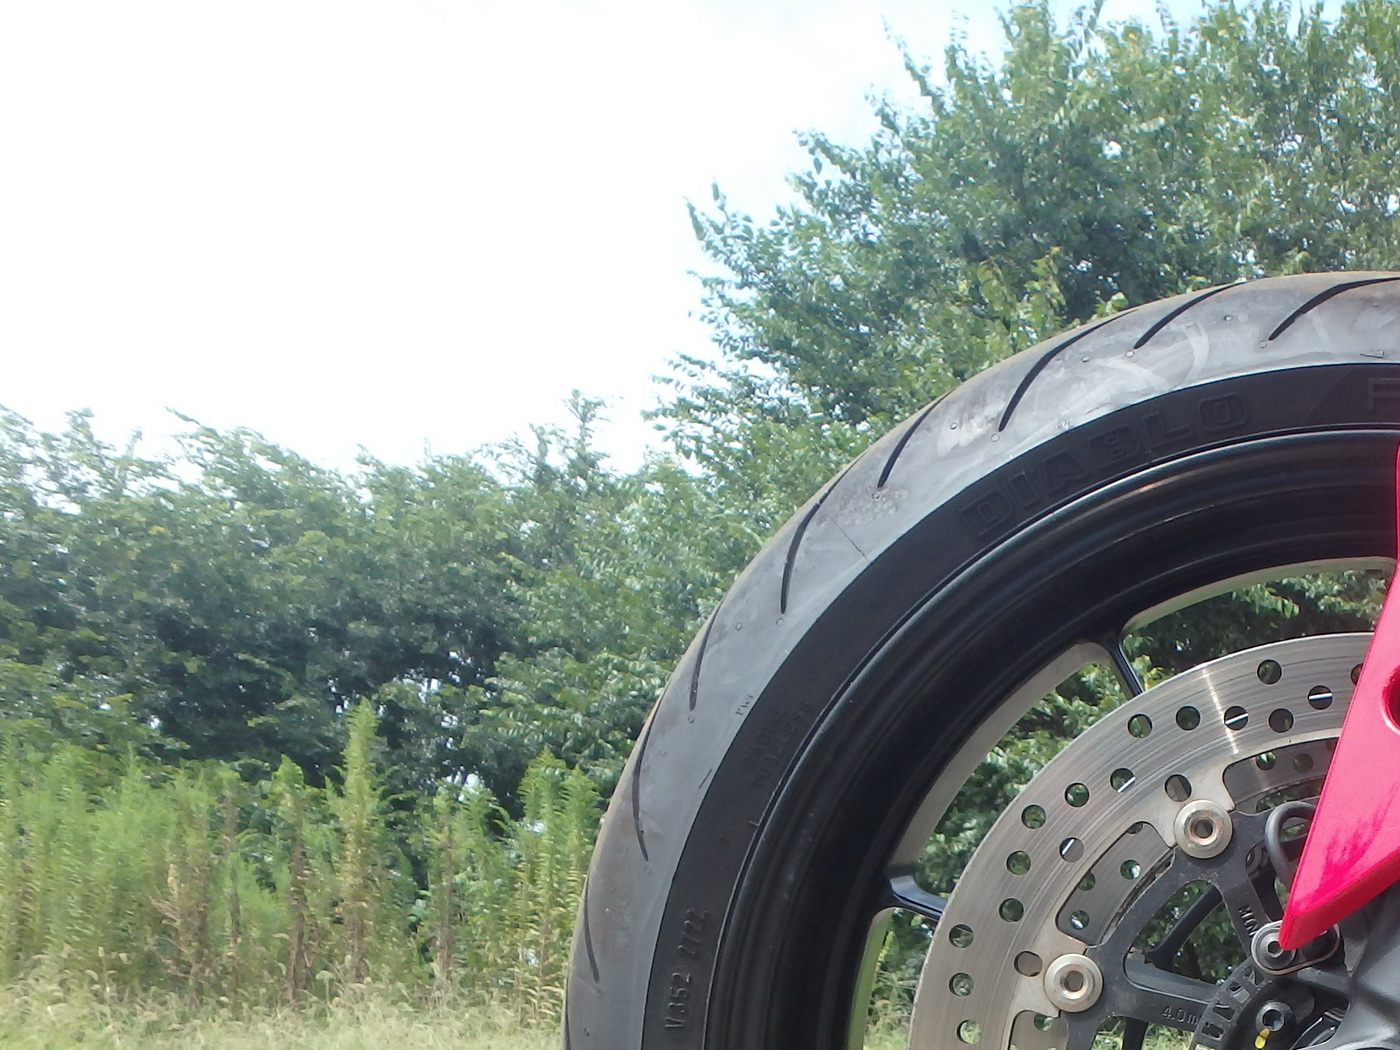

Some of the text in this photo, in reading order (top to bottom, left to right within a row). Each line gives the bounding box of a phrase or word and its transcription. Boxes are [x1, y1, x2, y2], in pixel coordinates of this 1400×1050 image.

[957, 392, 1249, 538] DIABLO
[674, 904, 708, 959] 2722
[663, 970, 693, 1030] V352
